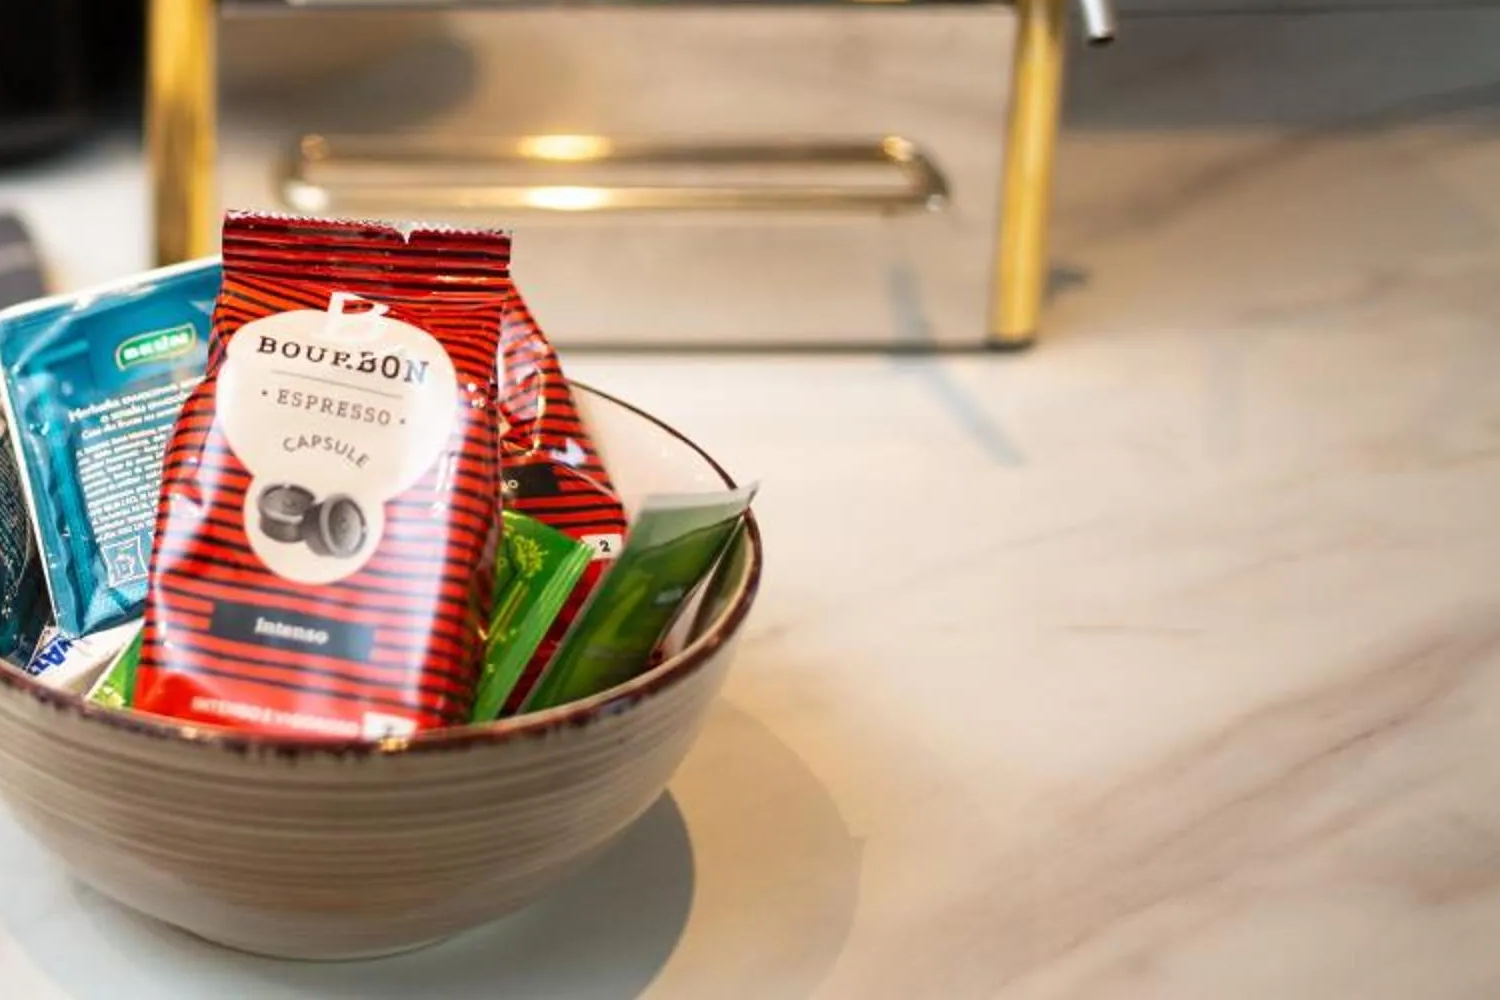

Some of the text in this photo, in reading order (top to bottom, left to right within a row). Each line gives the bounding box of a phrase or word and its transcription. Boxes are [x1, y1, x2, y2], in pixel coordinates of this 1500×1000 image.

[257, 335, 429, 383] BOURBON
[277, 388, 392, 427] ESPRESSO
[282, 433, 370, 469] CAPSULE
[599, 540, 611, 553] 2
